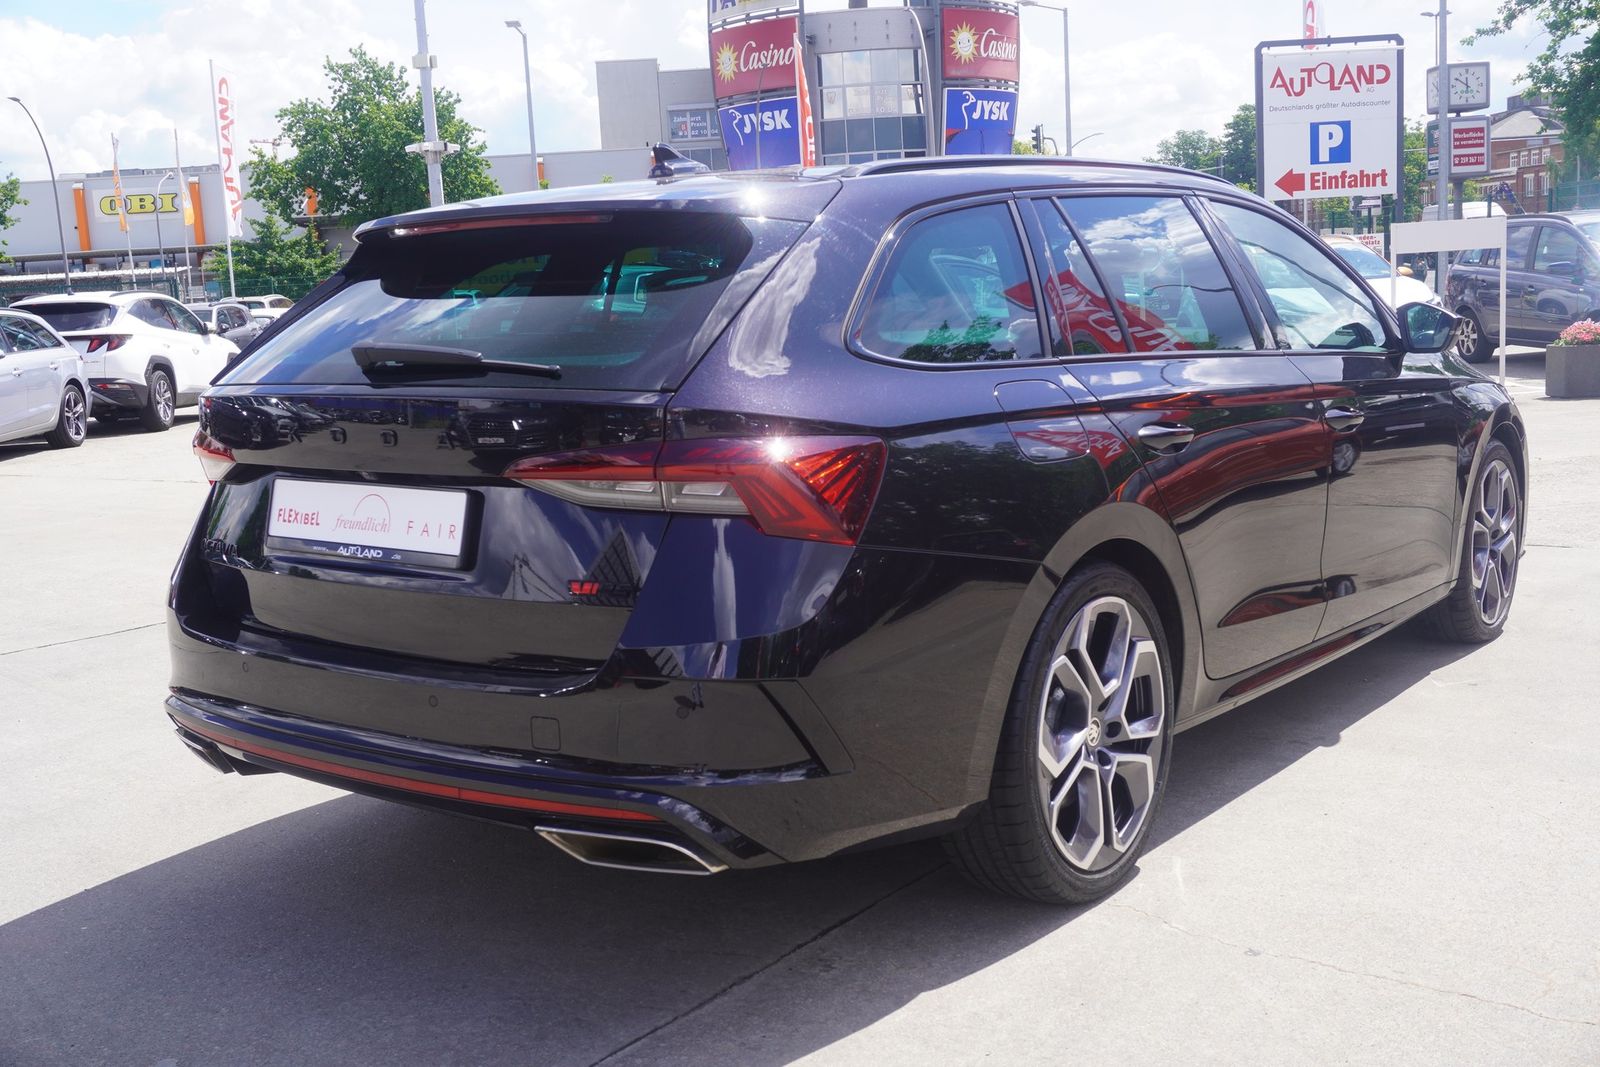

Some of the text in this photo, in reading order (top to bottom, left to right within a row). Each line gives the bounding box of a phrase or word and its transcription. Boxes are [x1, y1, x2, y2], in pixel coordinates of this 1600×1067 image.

[740, 41, 796, 72] Casino
[980, 28, 1017, 60] Casino
[1269, 62, 1391, 97] AUTOLAND
[972, 100, 1010, 120] JYSK
[1269, 100, 1391, 112] Deutschlands größter Autodiscounter
[743, 109, 792, 134] JYSK
[1319, 124, 1344, 162] P
[1310, 169, 1388, 191] Einfahrt
[100, 193, 178, 215] OBI
[277, 508, 456, 539] FLEXIBEL freundlich FAIR
[337, 545, 383, 558] AUTOLAND
